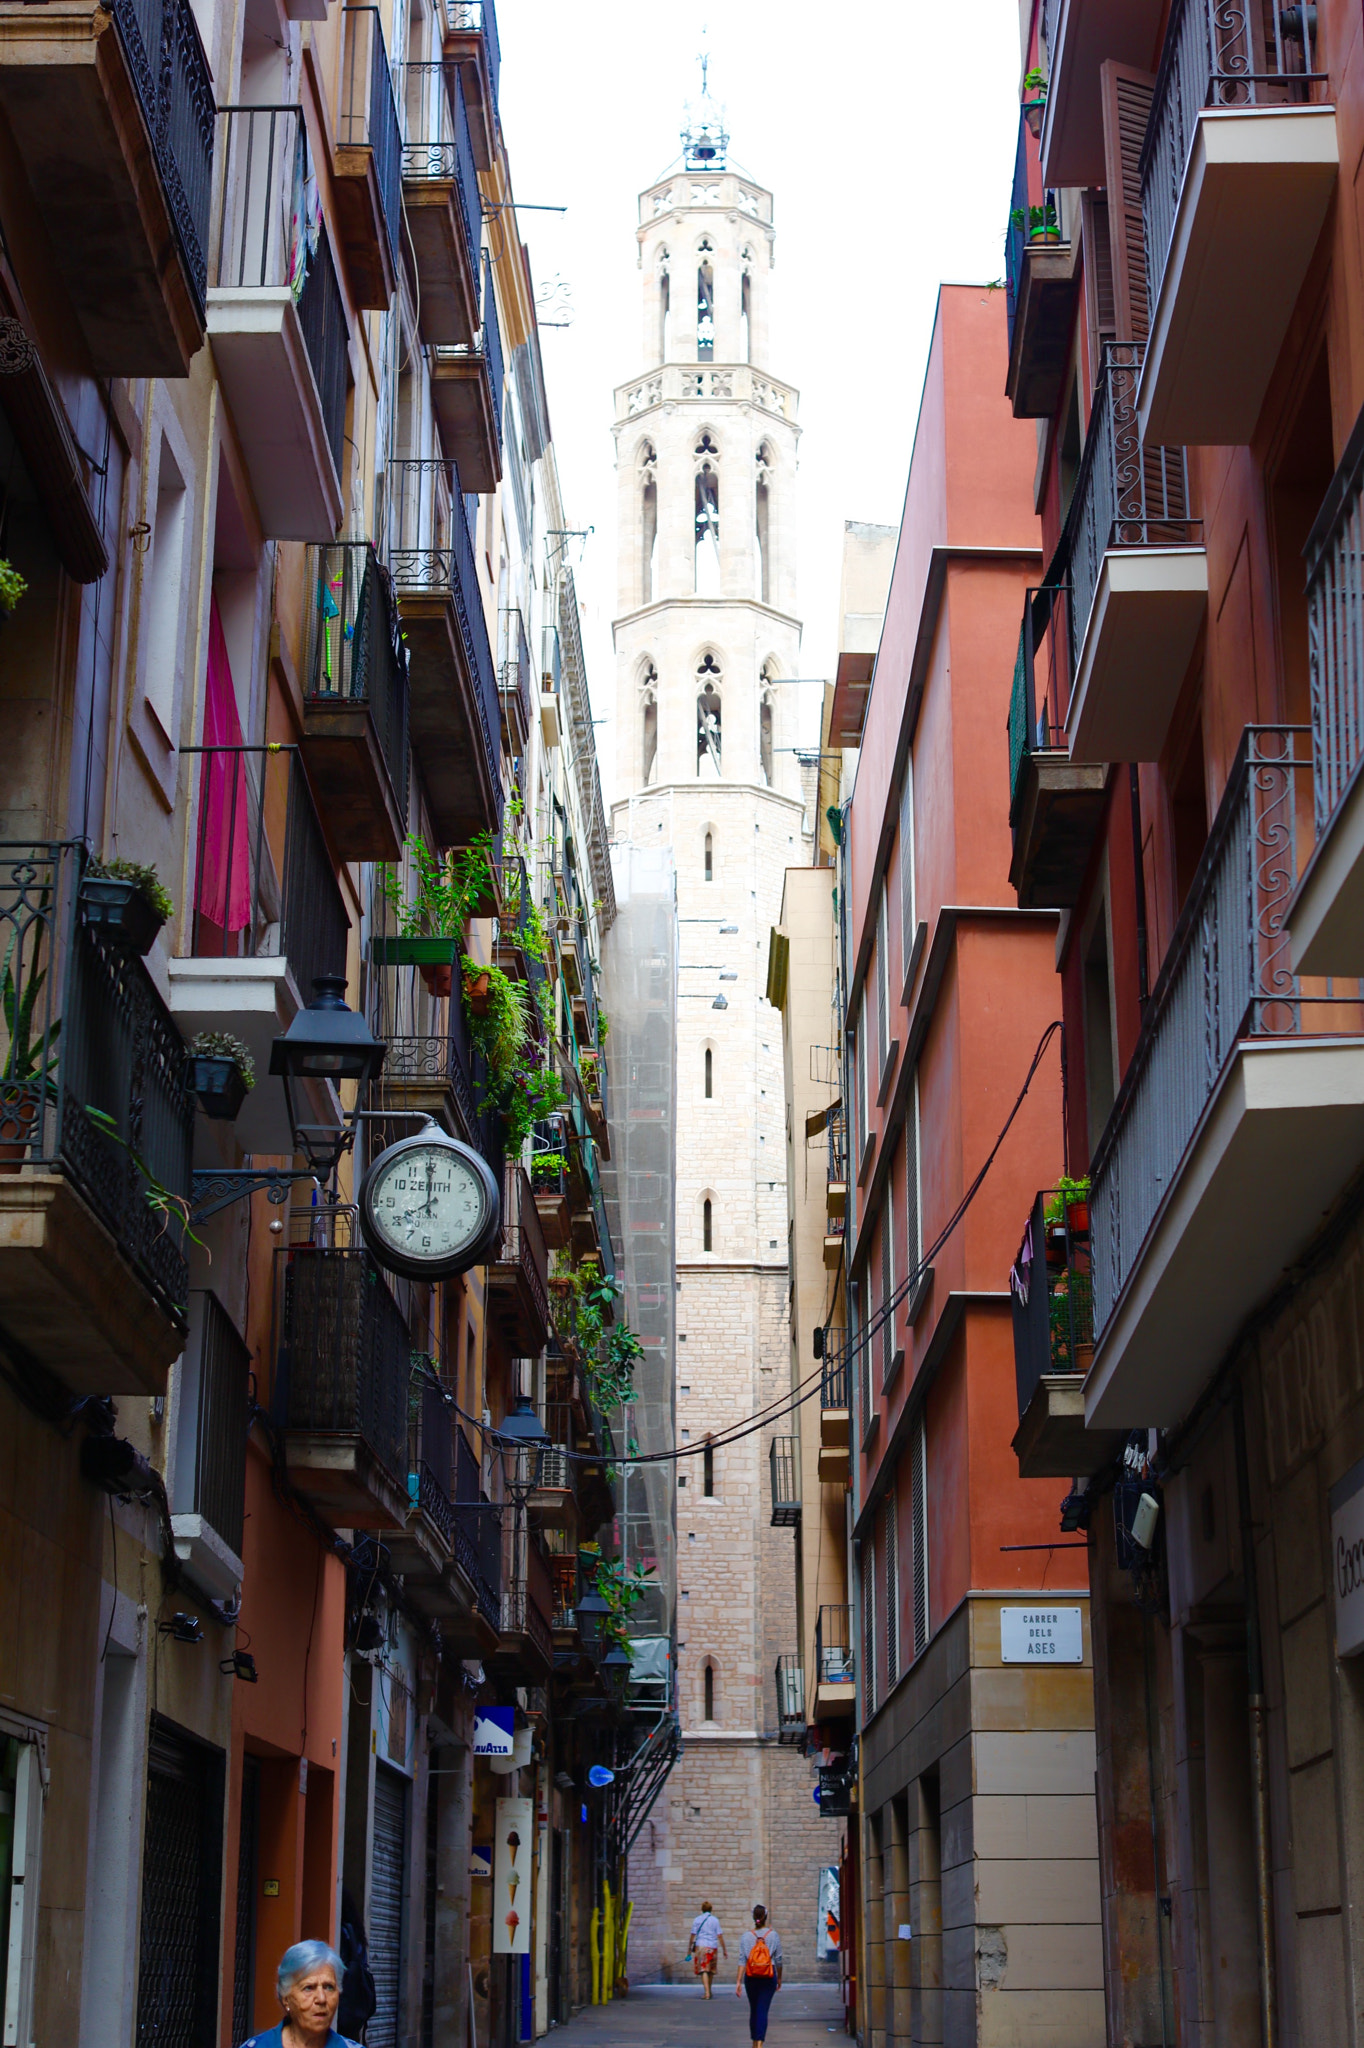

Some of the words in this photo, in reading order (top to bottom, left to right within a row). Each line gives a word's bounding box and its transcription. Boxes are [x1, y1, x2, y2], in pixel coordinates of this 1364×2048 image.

[410, 1180, 451, 1193] ZENITH
[458, 1182, 467, 1194] 2
[386, 1197, 396, 1208] 9
[463, 1201, 472, 1212] 3
[454, 1219, 465, 1231] 4
[406, 1229, 415, 1241] 7
[1023, 1615, 1058, 1623] CARRER
[1029, 1629, 1053, 1637] DELS
[1027, 1642, 1056, 1654] ASES
[474, 1742, 508, 1753] AVAZZA
